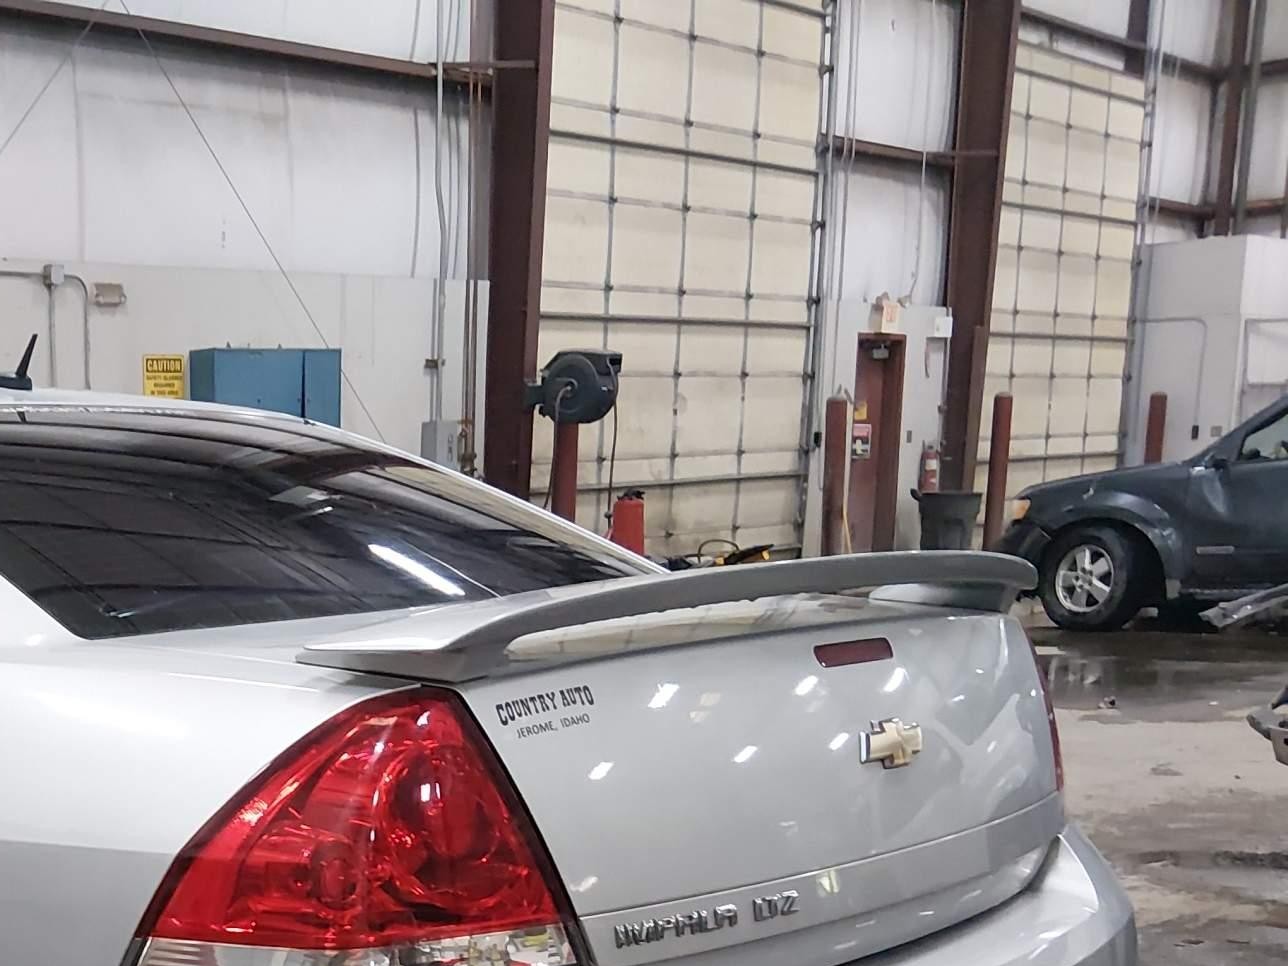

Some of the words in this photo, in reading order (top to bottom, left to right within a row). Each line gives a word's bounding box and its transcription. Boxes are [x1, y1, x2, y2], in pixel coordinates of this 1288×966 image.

[147, 359, 181, 372] CAUTION
[495, 691, 558, 727] COUNTRY
[559, 684, 595, 708] AUTO
[560, 712, 591, 729] IDAHO
[614, 902, 739, 950] IMPALA
[751, 889, 800, 923] LTZ
